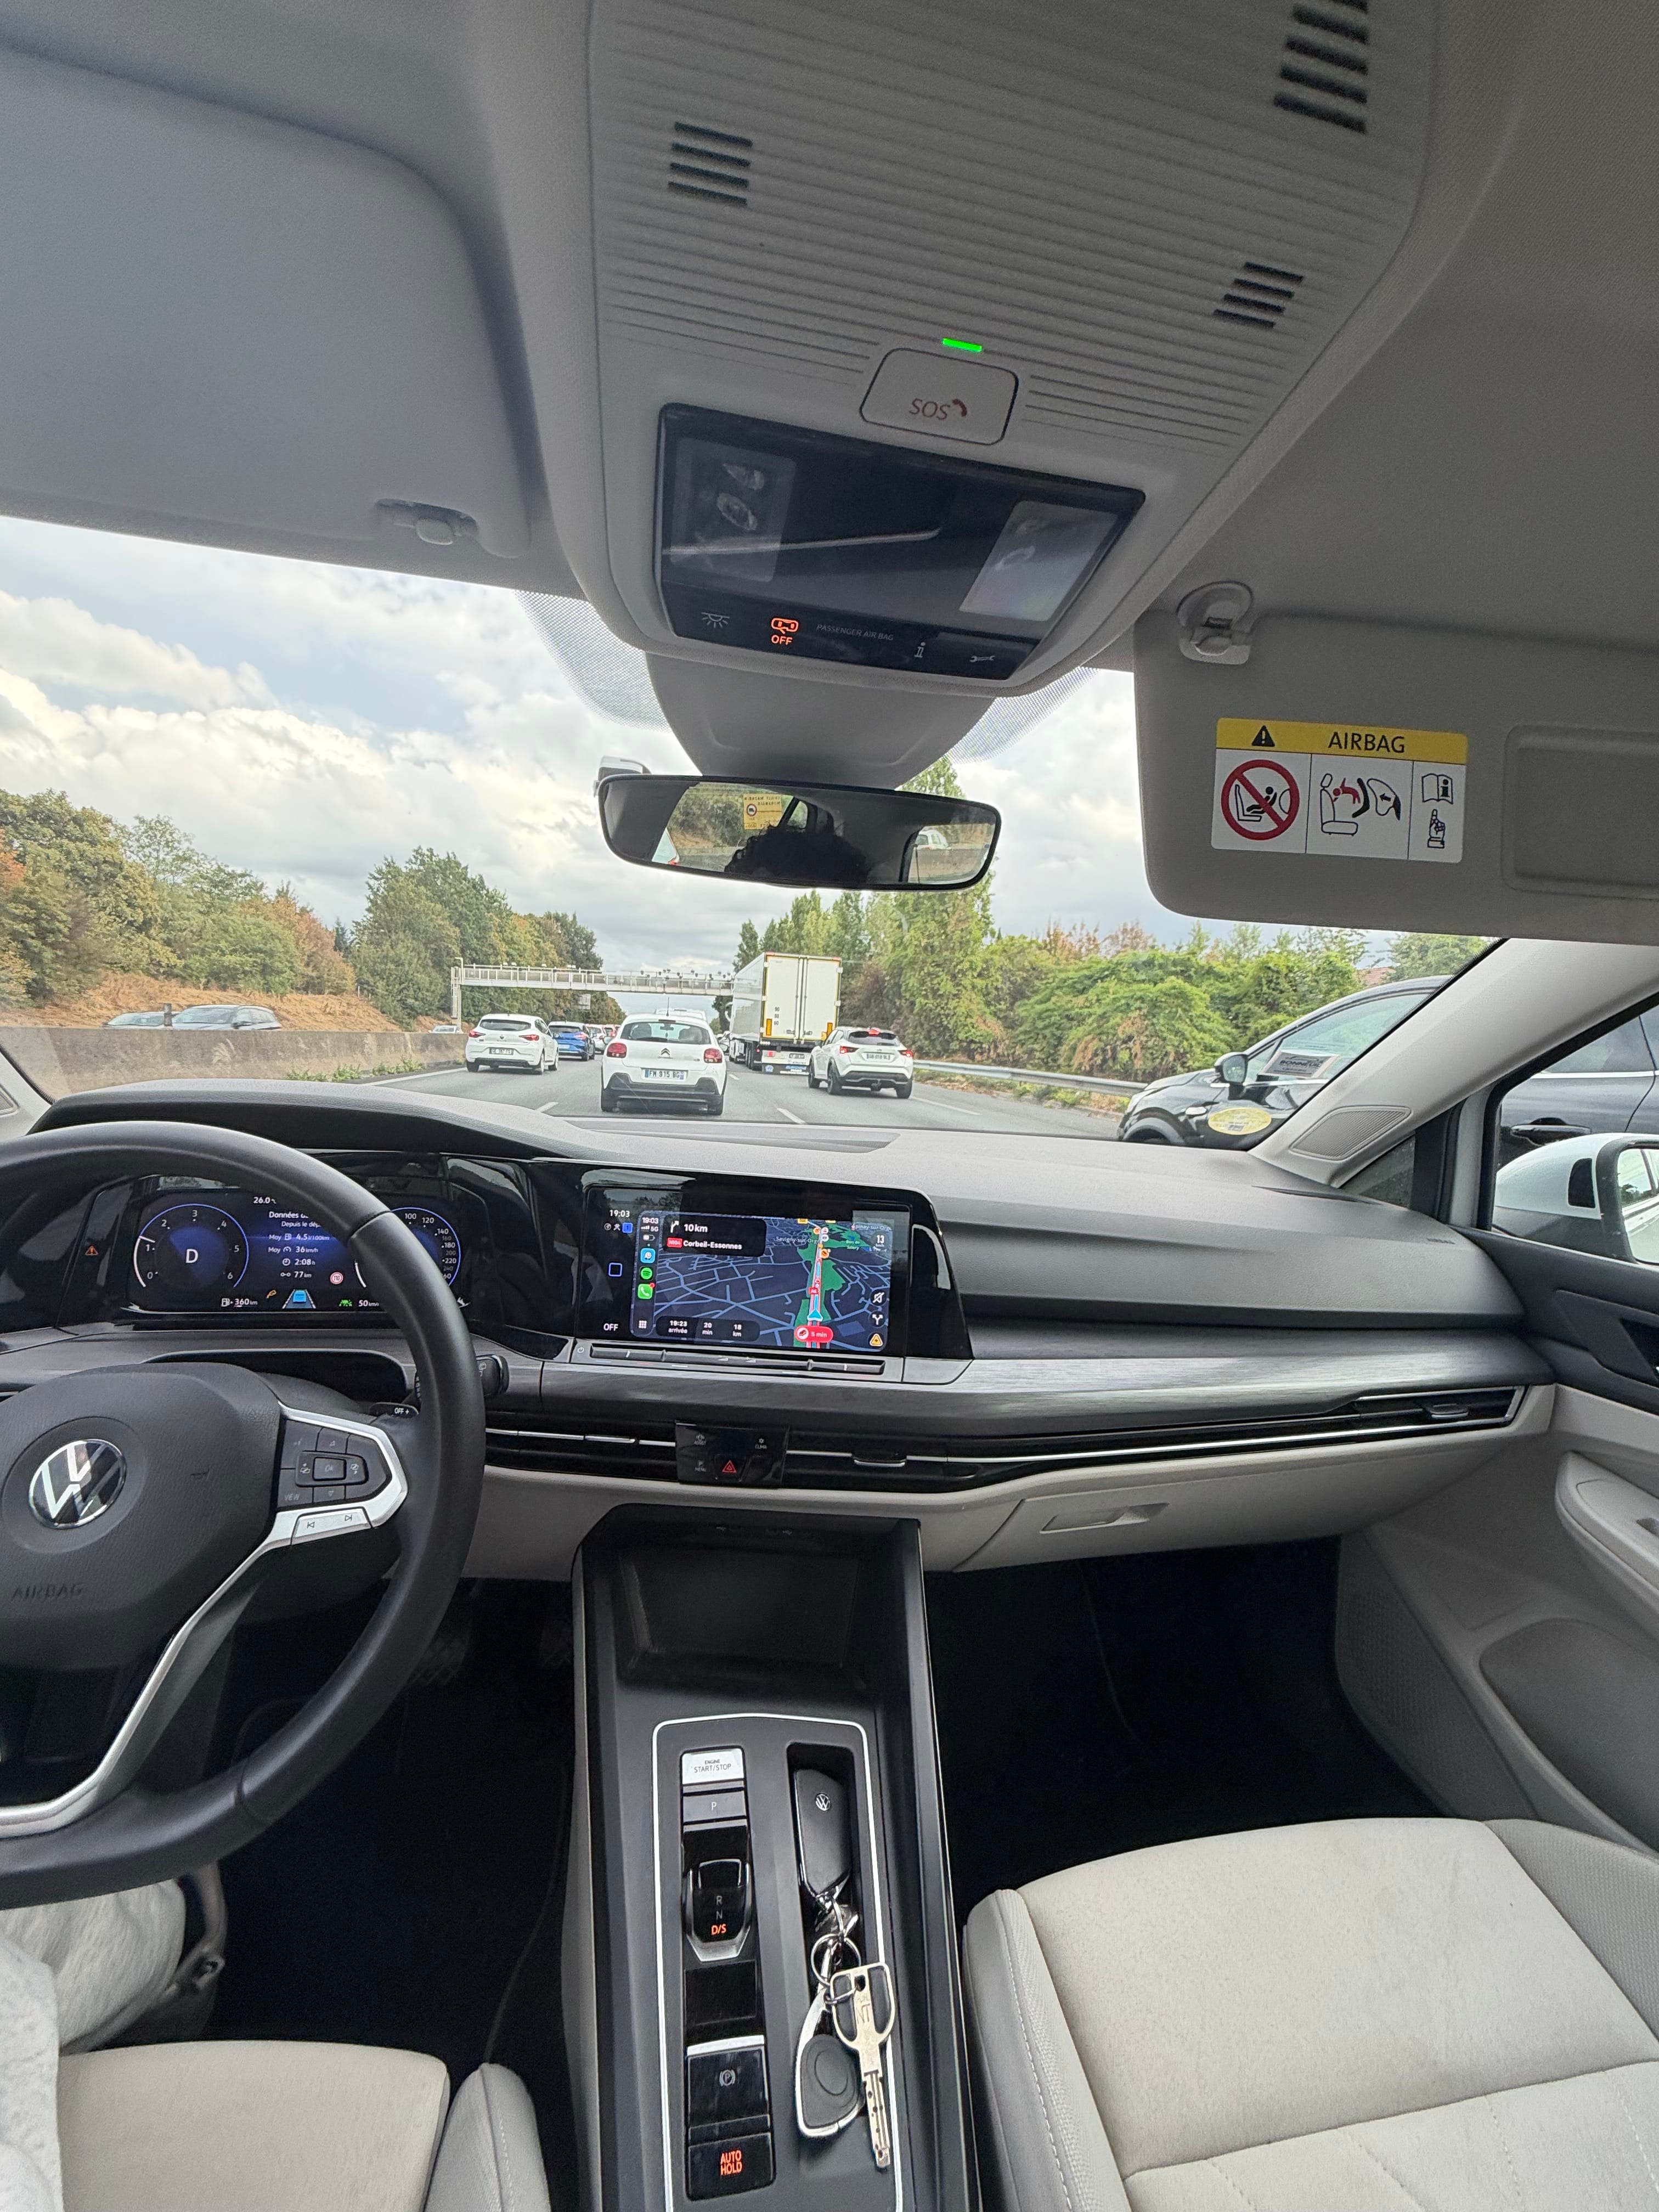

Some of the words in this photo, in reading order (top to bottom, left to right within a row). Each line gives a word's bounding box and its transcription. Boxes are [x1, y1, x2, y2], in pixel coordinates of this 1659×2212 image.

[909, 398, 950, 420] SOS
[816, 623, 862, 636] PASSENGER
[878, 633, 894, 641] BAG
[771, 635, 793, 645] OFF
[1328, 731, 1406, 754] AIRBAG
[610, 1209, 630, 1217] 19:03
[876, 1235, 884, 1244] 13
[683, 1240, 742, 1250] Corbeil-Essonnes
[185, 1249, 198, 1263] D
[603, 1323, 618, 1331] OFF
[694, 1763, 731, 1773] START/STOP
[711, 1802, 717, 1810] P
[716, 1895, 723, 1905] R
[716, 1910, 723, 1919] N
[711, 1923, 726, 1936] D/S
[720, 2151, 742, 2164] AUTO
[720, 2163, 742, 2176] HOLD
